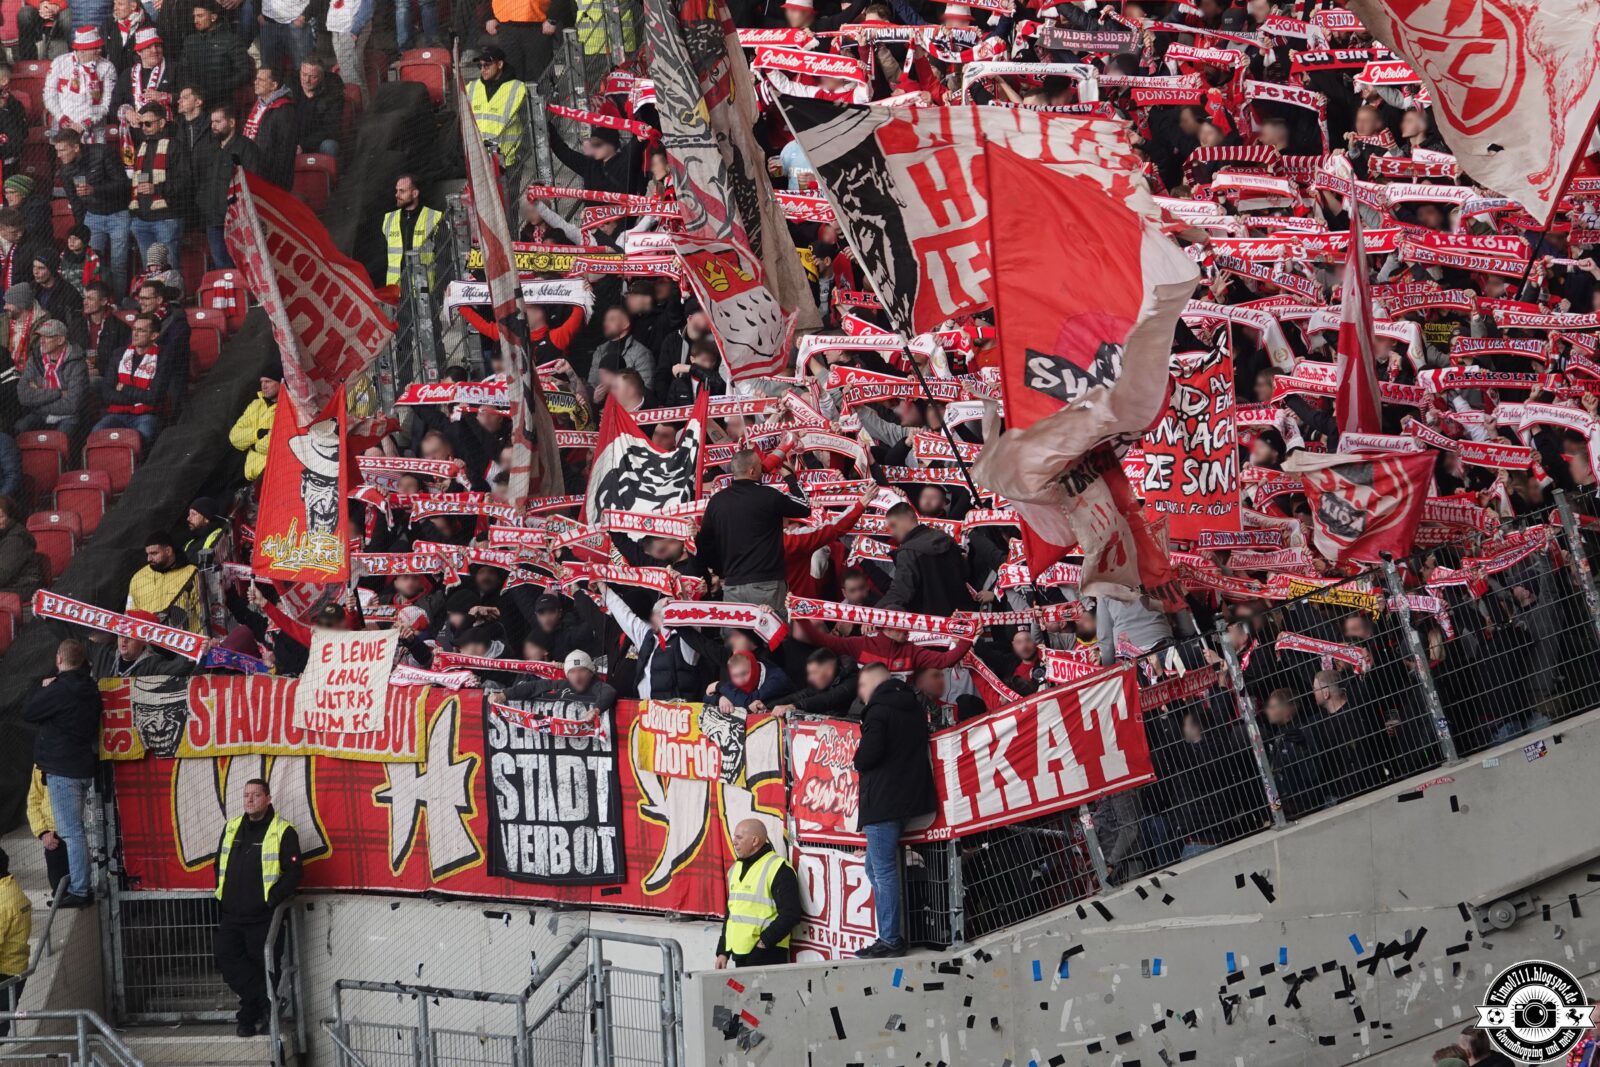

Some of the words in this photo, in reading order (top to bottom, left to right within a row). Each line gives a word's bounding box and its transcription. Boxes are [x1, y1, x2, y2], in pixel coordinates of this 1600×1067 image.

[1296, 52, 1329, 64] ICH
[1335, 50, 1369, 61] BIN
[1136, 89, 1200, 102] DOMSTADT
[1254, 85, 1280, 98] FC
[1282, 88, 1320, 107] KÖL
[596, 206, 627, 218] SIND
[1471, 235, 1521, 252] KÖLN
[537, 283, 573, 297] Stadion
[863, 384, 890, 398] SIND
[1210, 374, 1232, 394] AL
[1144, 453, 1175, 491] ZE
[1182, 450, 1237, 496] SIN!
[1188, 503, 1203, 514] FC
[1206, 500, 1233, 515] KÖLN
[822, 601, 946, 632] SYNDIKAT
[135, 623, 196, 653] CLUB
[321, 641, 332, 662] E
[326, 667, 369, 688] LANG
[314, 688, 374, 710] ULTRAS
[303, 710, 344, 731] VUM
[352, 712, 371, 731] FC
[641, 700, 692, 739] Junge
[653, 735, 722, 782] Horde
[936, 675, 1130, 826] IKAT
[491, 755, 613, 823] STADT
[927, 828, 952, 841] 2007
[500, 823, 616, 876] VERBOT
